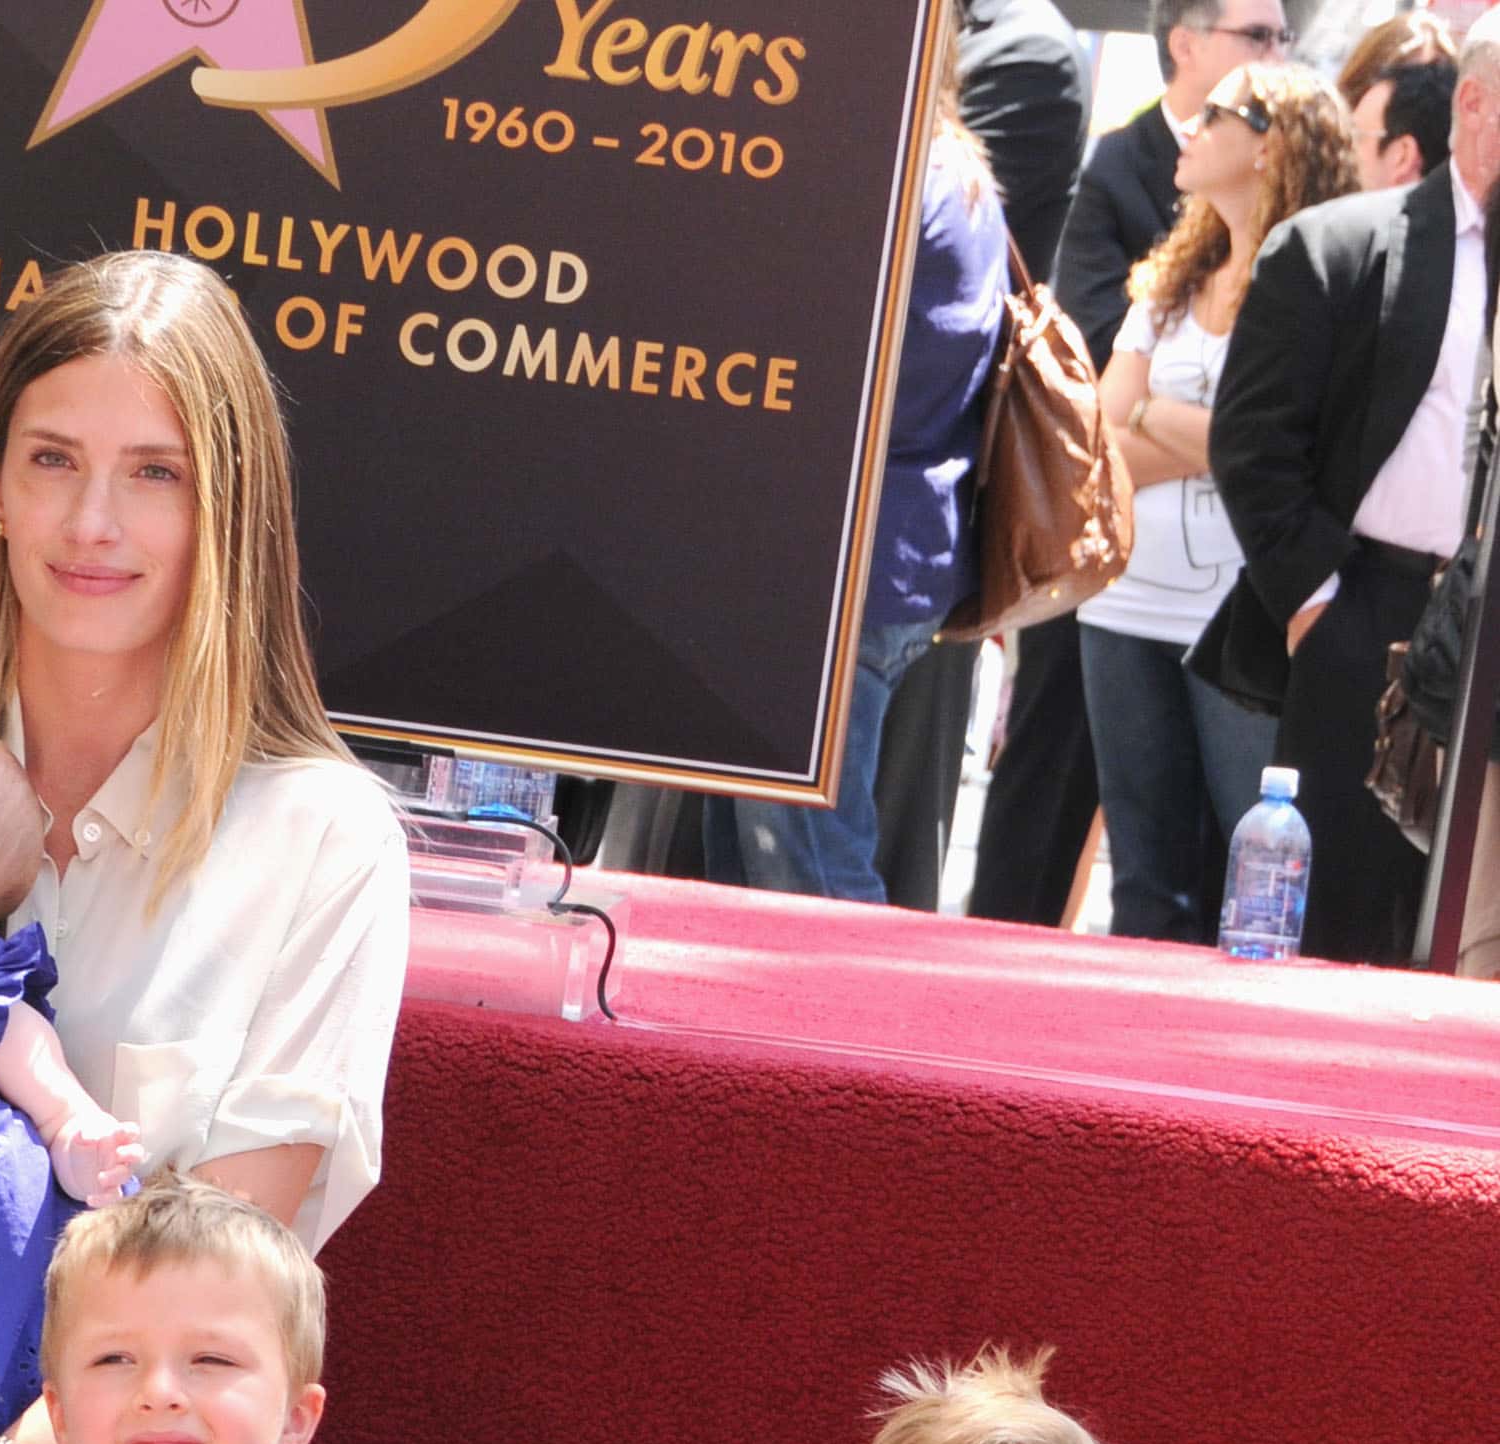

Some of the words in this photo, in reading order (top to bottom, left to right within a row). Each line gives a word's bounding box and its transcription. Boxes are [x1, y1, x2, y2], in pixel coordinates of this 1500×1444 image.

[543, 0, 806, 105] Years
[443, 97, 576, 153] 1960
[635, 122, 784, 179] 2010
[133, 197, 588, 304] HOLLYWOOD
[275, 296, 366, 355] OF
[399, 312, 797, 411] COMMERCE
